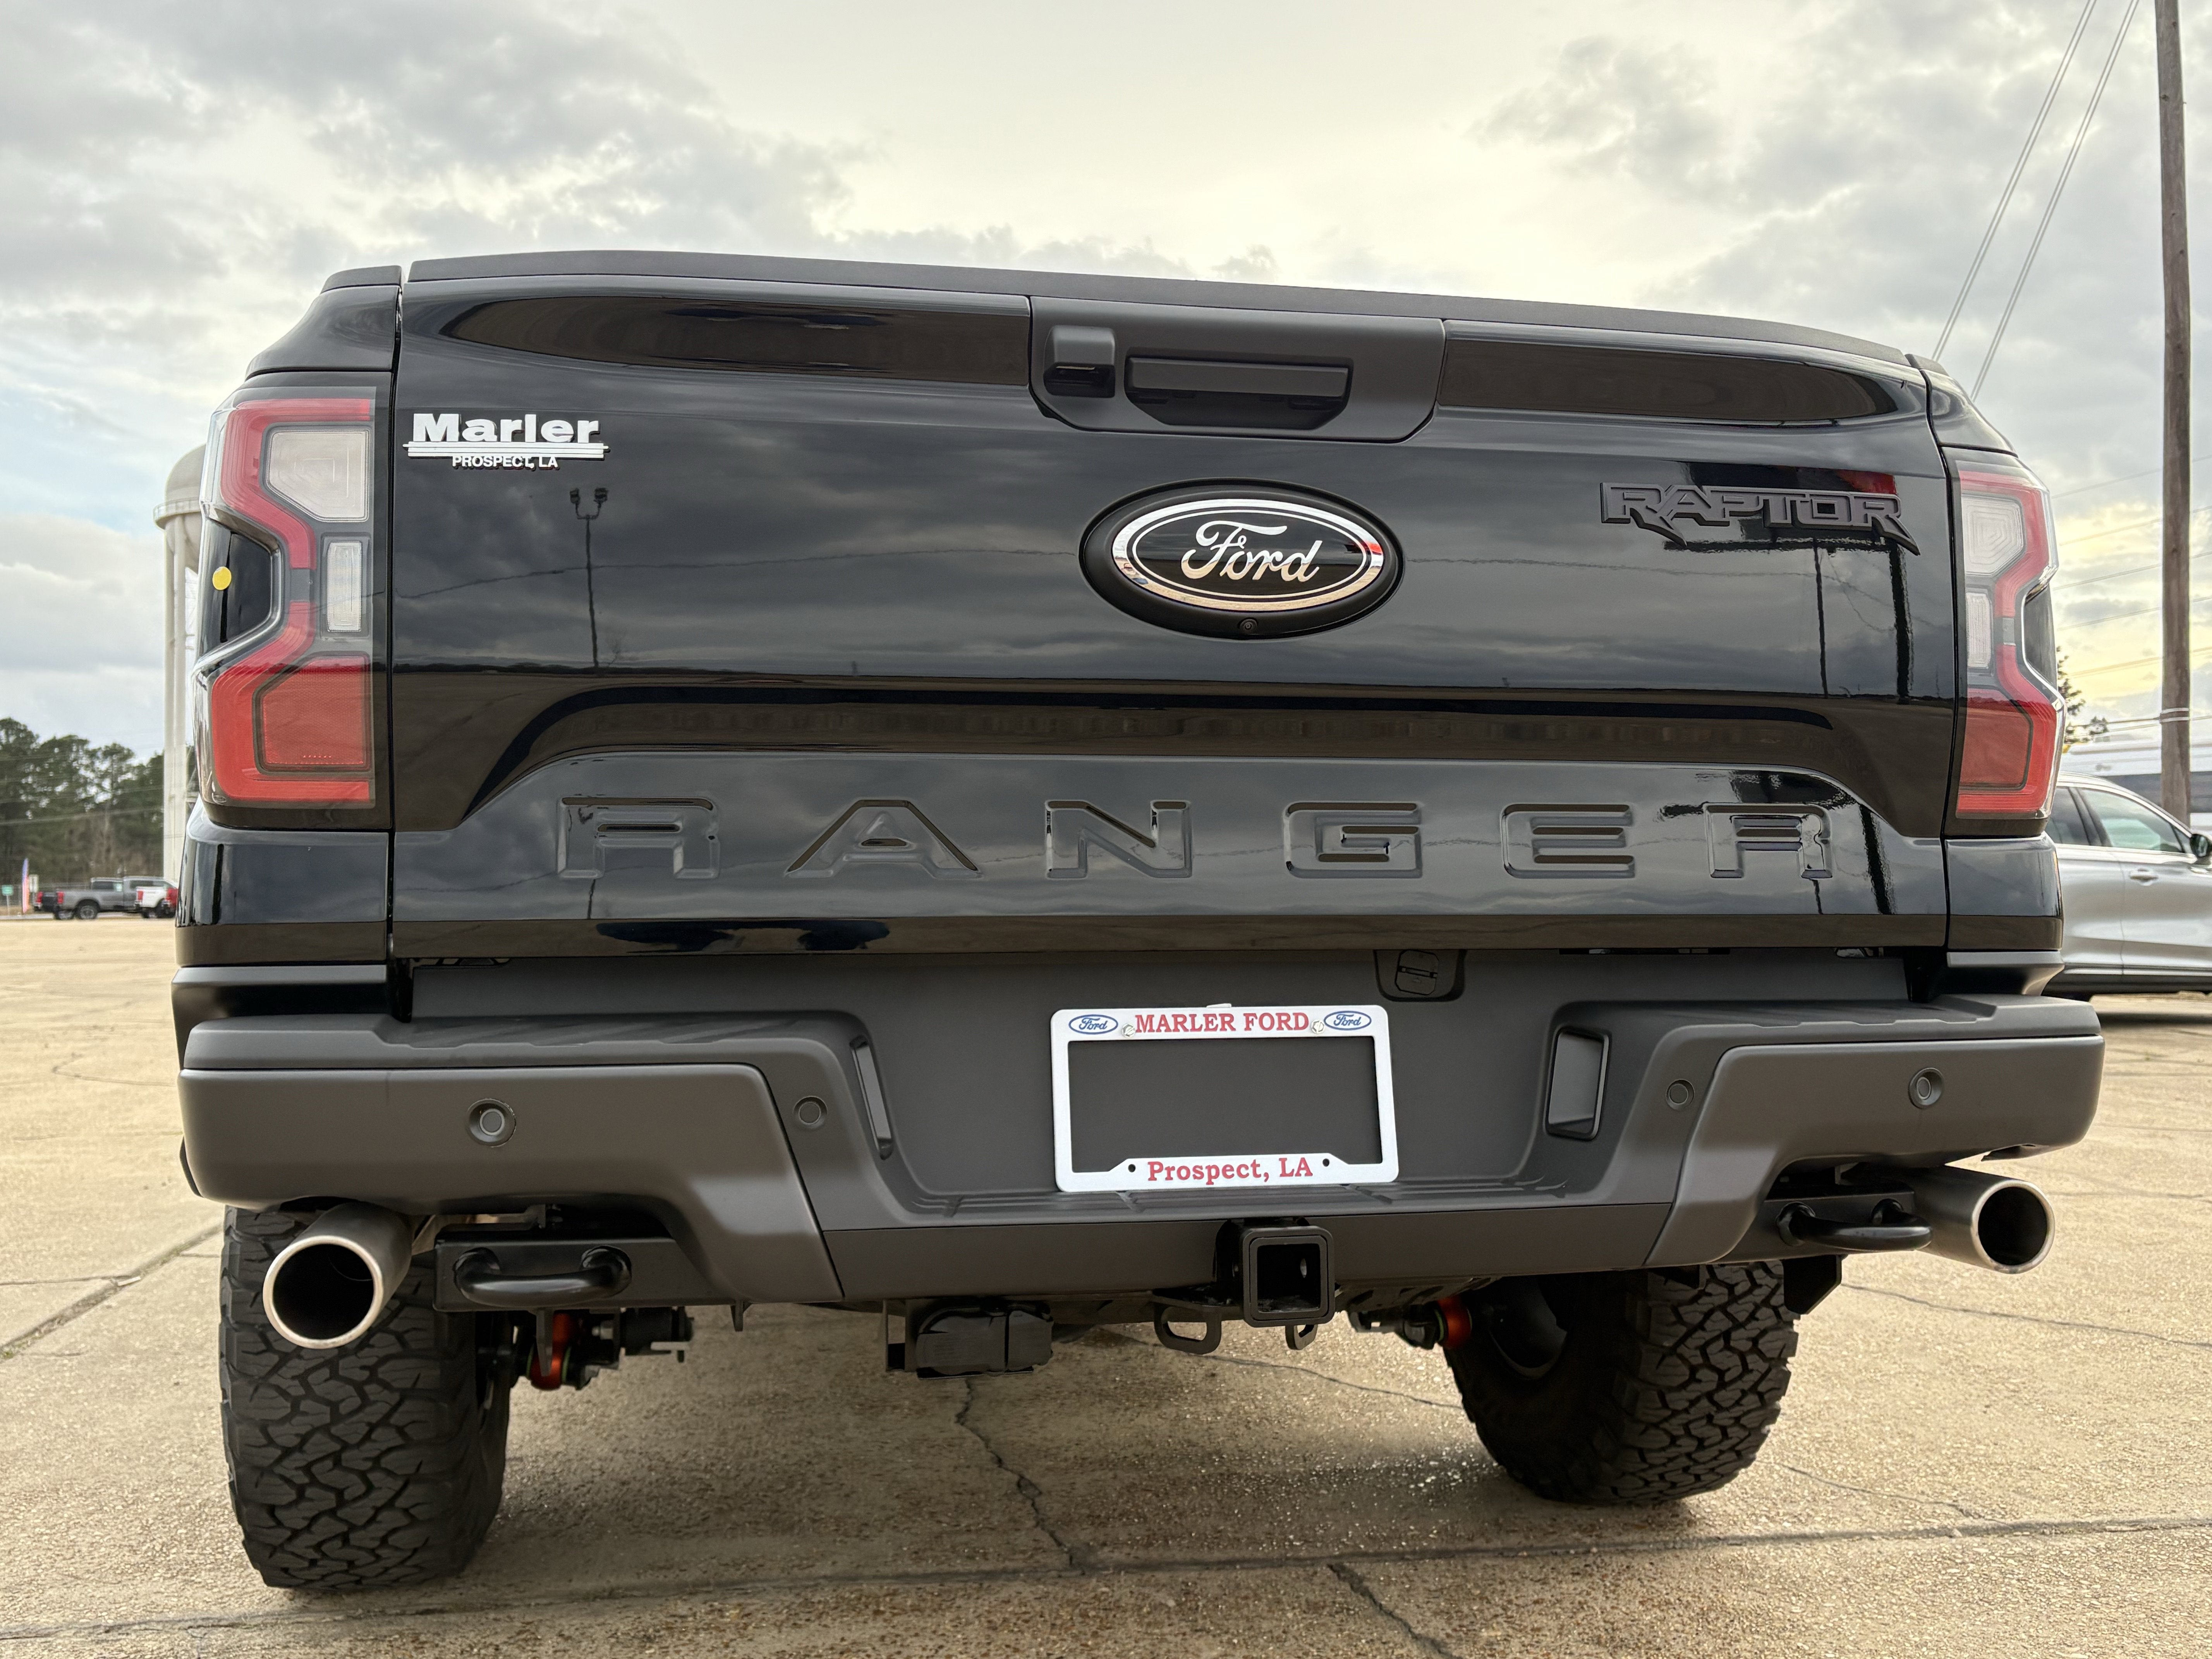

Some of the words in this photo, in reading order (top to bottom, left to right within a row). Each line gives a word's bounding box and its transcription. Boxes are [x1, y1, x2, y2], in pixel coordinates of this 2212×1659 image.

[413, 413, 600, 443] Marler
[452, 456, 534, 469] PROSPECT,
[538, 456, 558, 468] LA
[1600, 482, 1921, 556] RAPTOR
[1181, 520, 1323, 582] Ford
[557, 796, 1832, 879] RANGER
[1079, 1017, 1108, 1030] Ford
[1135, 1013, 1236, 1033] MARLER
[1243, 1012, 1309, 1032] FORD
[1333, 1013, 1362, 1026] Ford
[1147, 1158, 1270, 1185] Prospect,
[1279, 1157, 1313, 1178] LA
